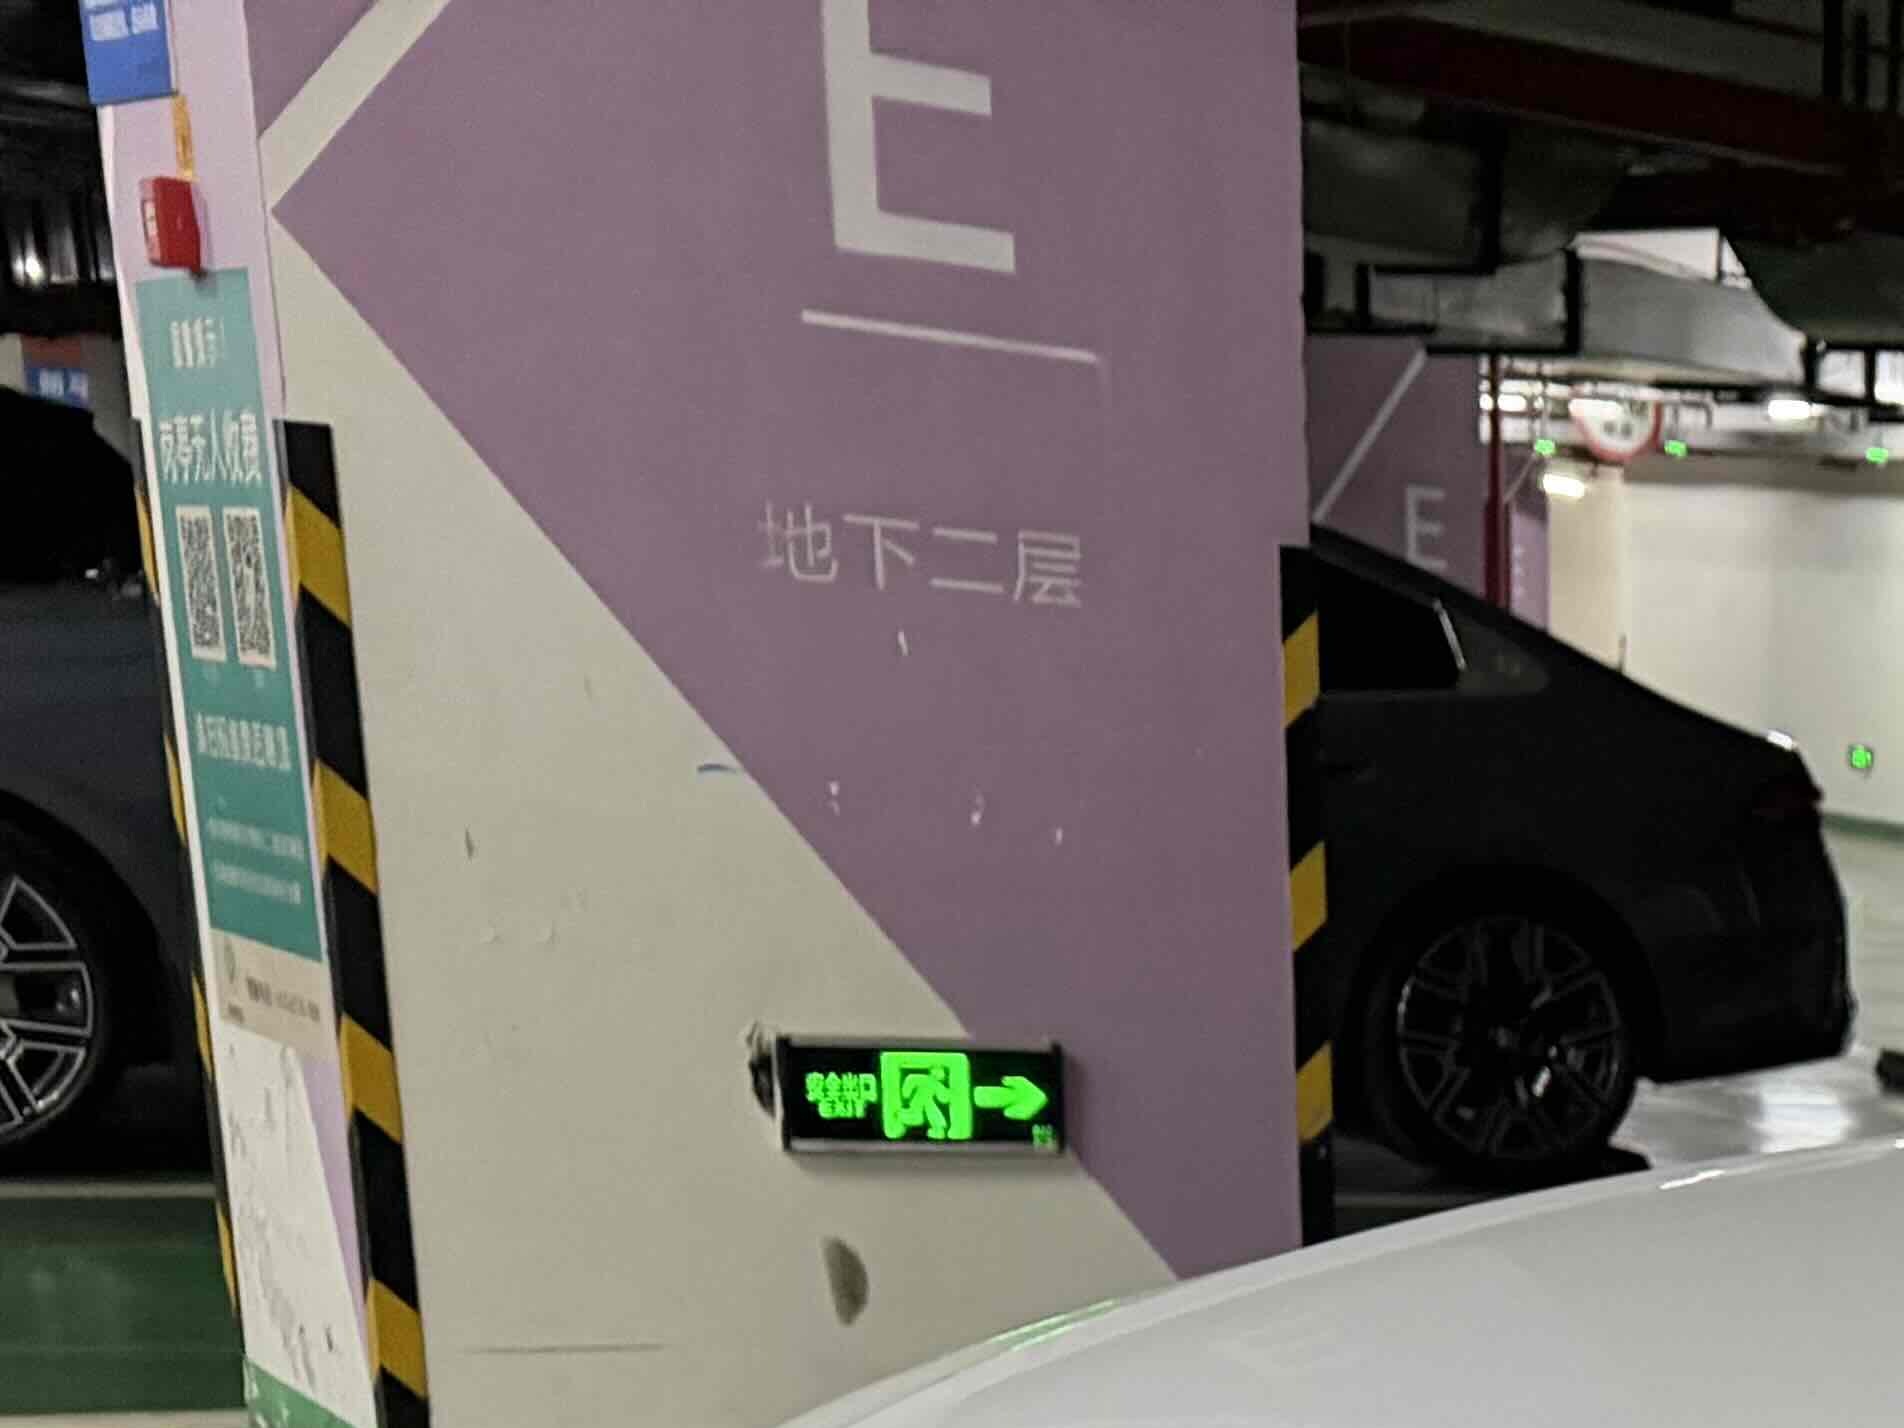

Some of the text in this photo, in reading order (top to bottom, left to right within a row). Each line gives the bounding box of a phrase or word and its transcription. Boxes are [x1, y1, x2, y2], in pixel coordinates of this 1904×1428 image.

[822, 0, 1016, 273] E
[756, 502, 1083, 606] 地下二层
[1404, 484, 1448, 573] E
[806, 1071, 878, 1105] 安全出口
[817, 1101, 868, 1119] EXIT
